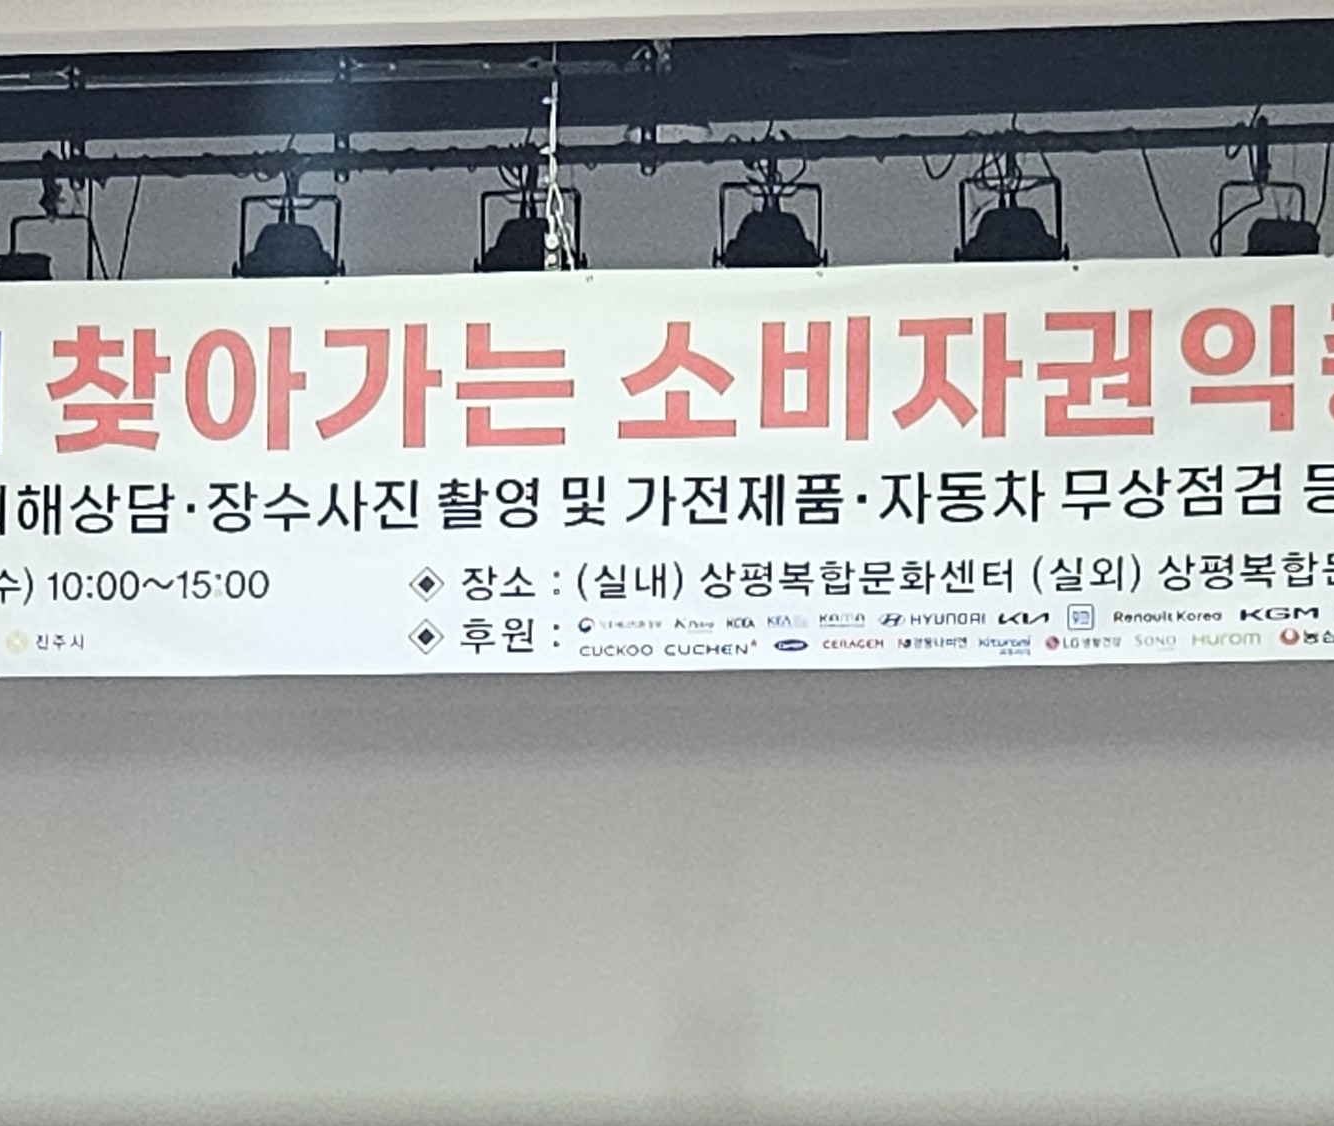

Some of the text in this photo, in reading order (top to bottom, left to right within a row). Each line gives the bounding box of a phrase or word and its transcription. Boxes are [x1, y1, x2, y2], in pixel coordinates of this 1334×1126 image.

[46, 323, 574, 454] 찾아가는
[438, 477, 539, 530] 촬영
[563, 475, 605, 528] 및
[1061, 462, 1282, 521] 무상점검
[462, 565, 536, 601] 장소
[578, 561, 683, 602] (실내)
[700, 558, 1012, 599] 상평복합문화센터
[1033, 553, 1140, 595] (실외)
[910, 613, 986, 625] HYUNDAI
[1113, 611, 1173, 623] Renault
[1176, 610, 1222, 621] Korea
[1240, 607, 1319, 621] KGM
[36, 634, 84, 651] 진주시
[460, 618, 534, 654] 후원
[579, 644, 653, 657] CUCKOO
[664, 643, 748, 656] CUCHEN
